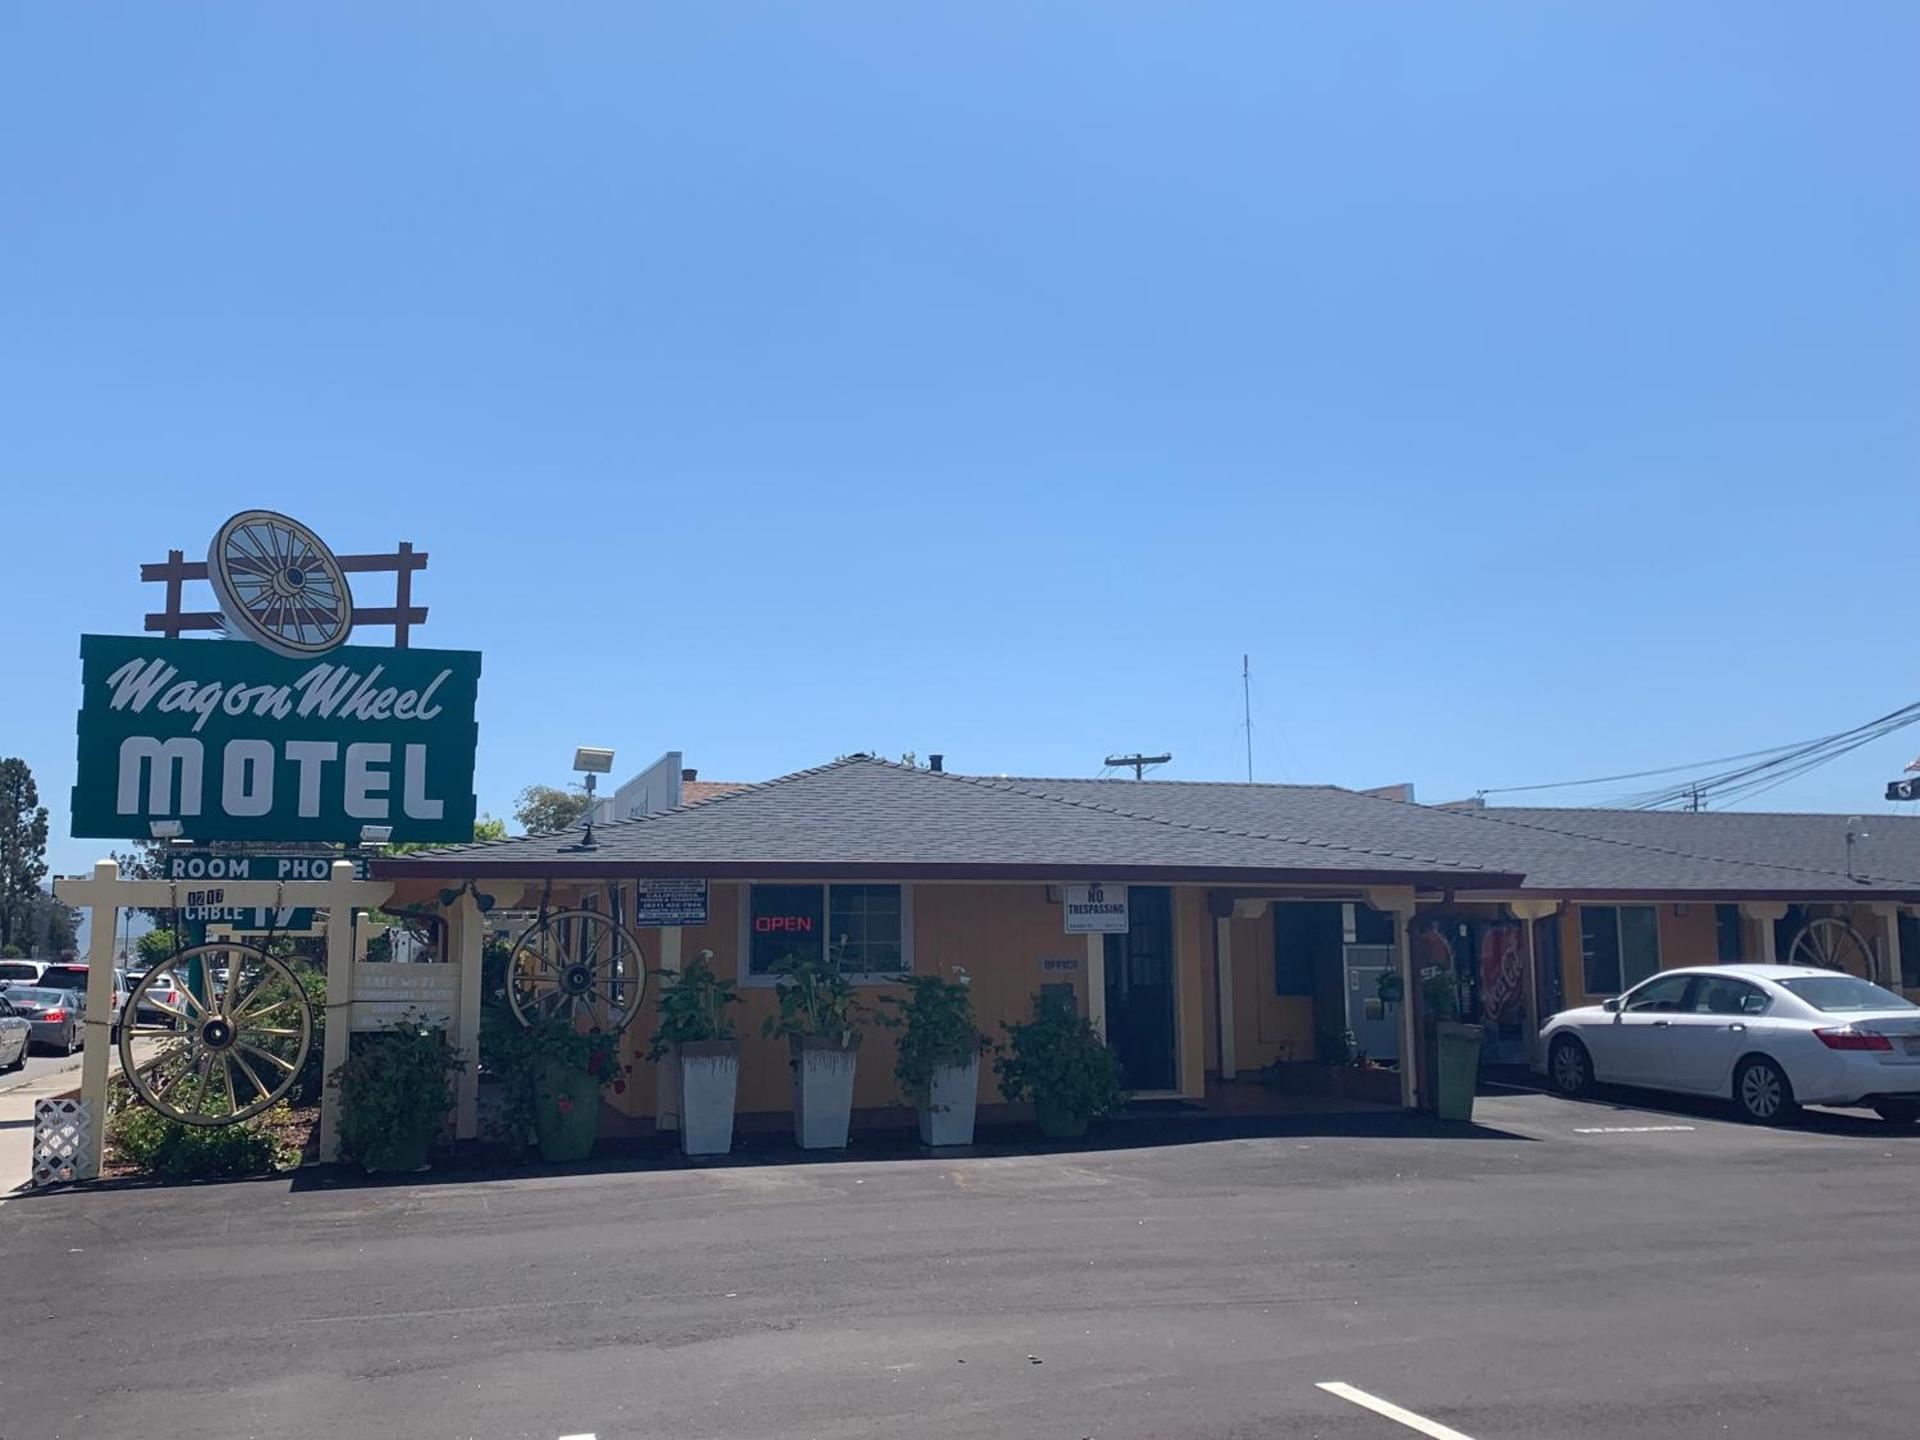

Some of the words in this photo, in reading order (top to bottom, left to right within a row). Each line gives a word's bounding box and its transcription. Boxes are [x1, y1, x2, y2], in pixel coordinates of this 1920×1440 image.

[106, 657, 293, 732] Wagon
[293, 662, 453, 722] Wheel
[116, 736, 444, 820] MOTEL
[171, 858, 249, 878] ROOM
[277, 859, 371, 879] PHOE
[189, 889, 224, 906] 1217
[1088, 889, 1104, 903] NO
[184, 907, 243, 920] CABLE
[1068, 903, 1124, 915] TRESPASSING
[756, 916, 812, 932] OPEN
[1044, 959, 1079, 970] OFFICE
